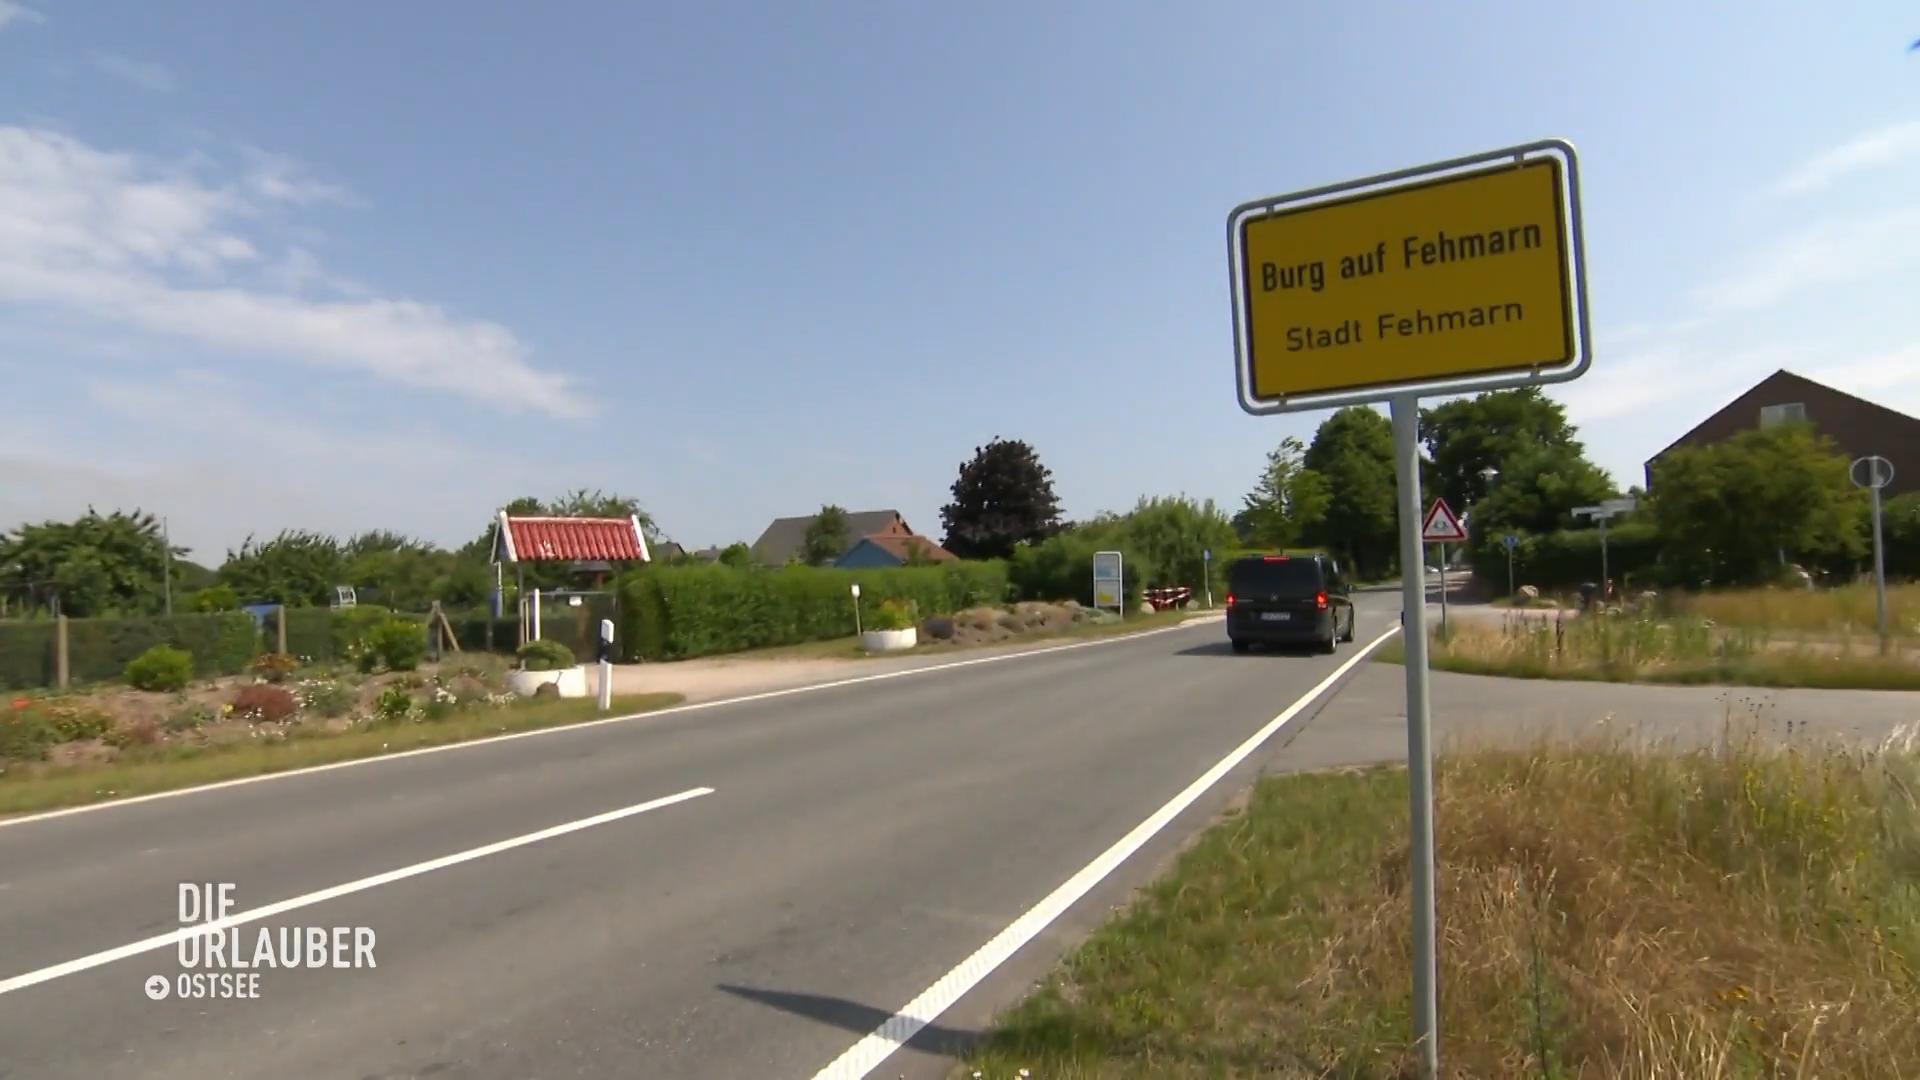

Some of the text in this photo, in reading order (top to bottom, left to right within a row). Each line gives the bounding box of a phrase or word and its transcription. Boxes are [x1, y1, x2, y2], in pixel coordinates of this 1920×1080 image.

[1262, 223, 1542, 293] Burg auf Fehmarn
[1285, 302, 1523, 353] Stadt Fehmarn
